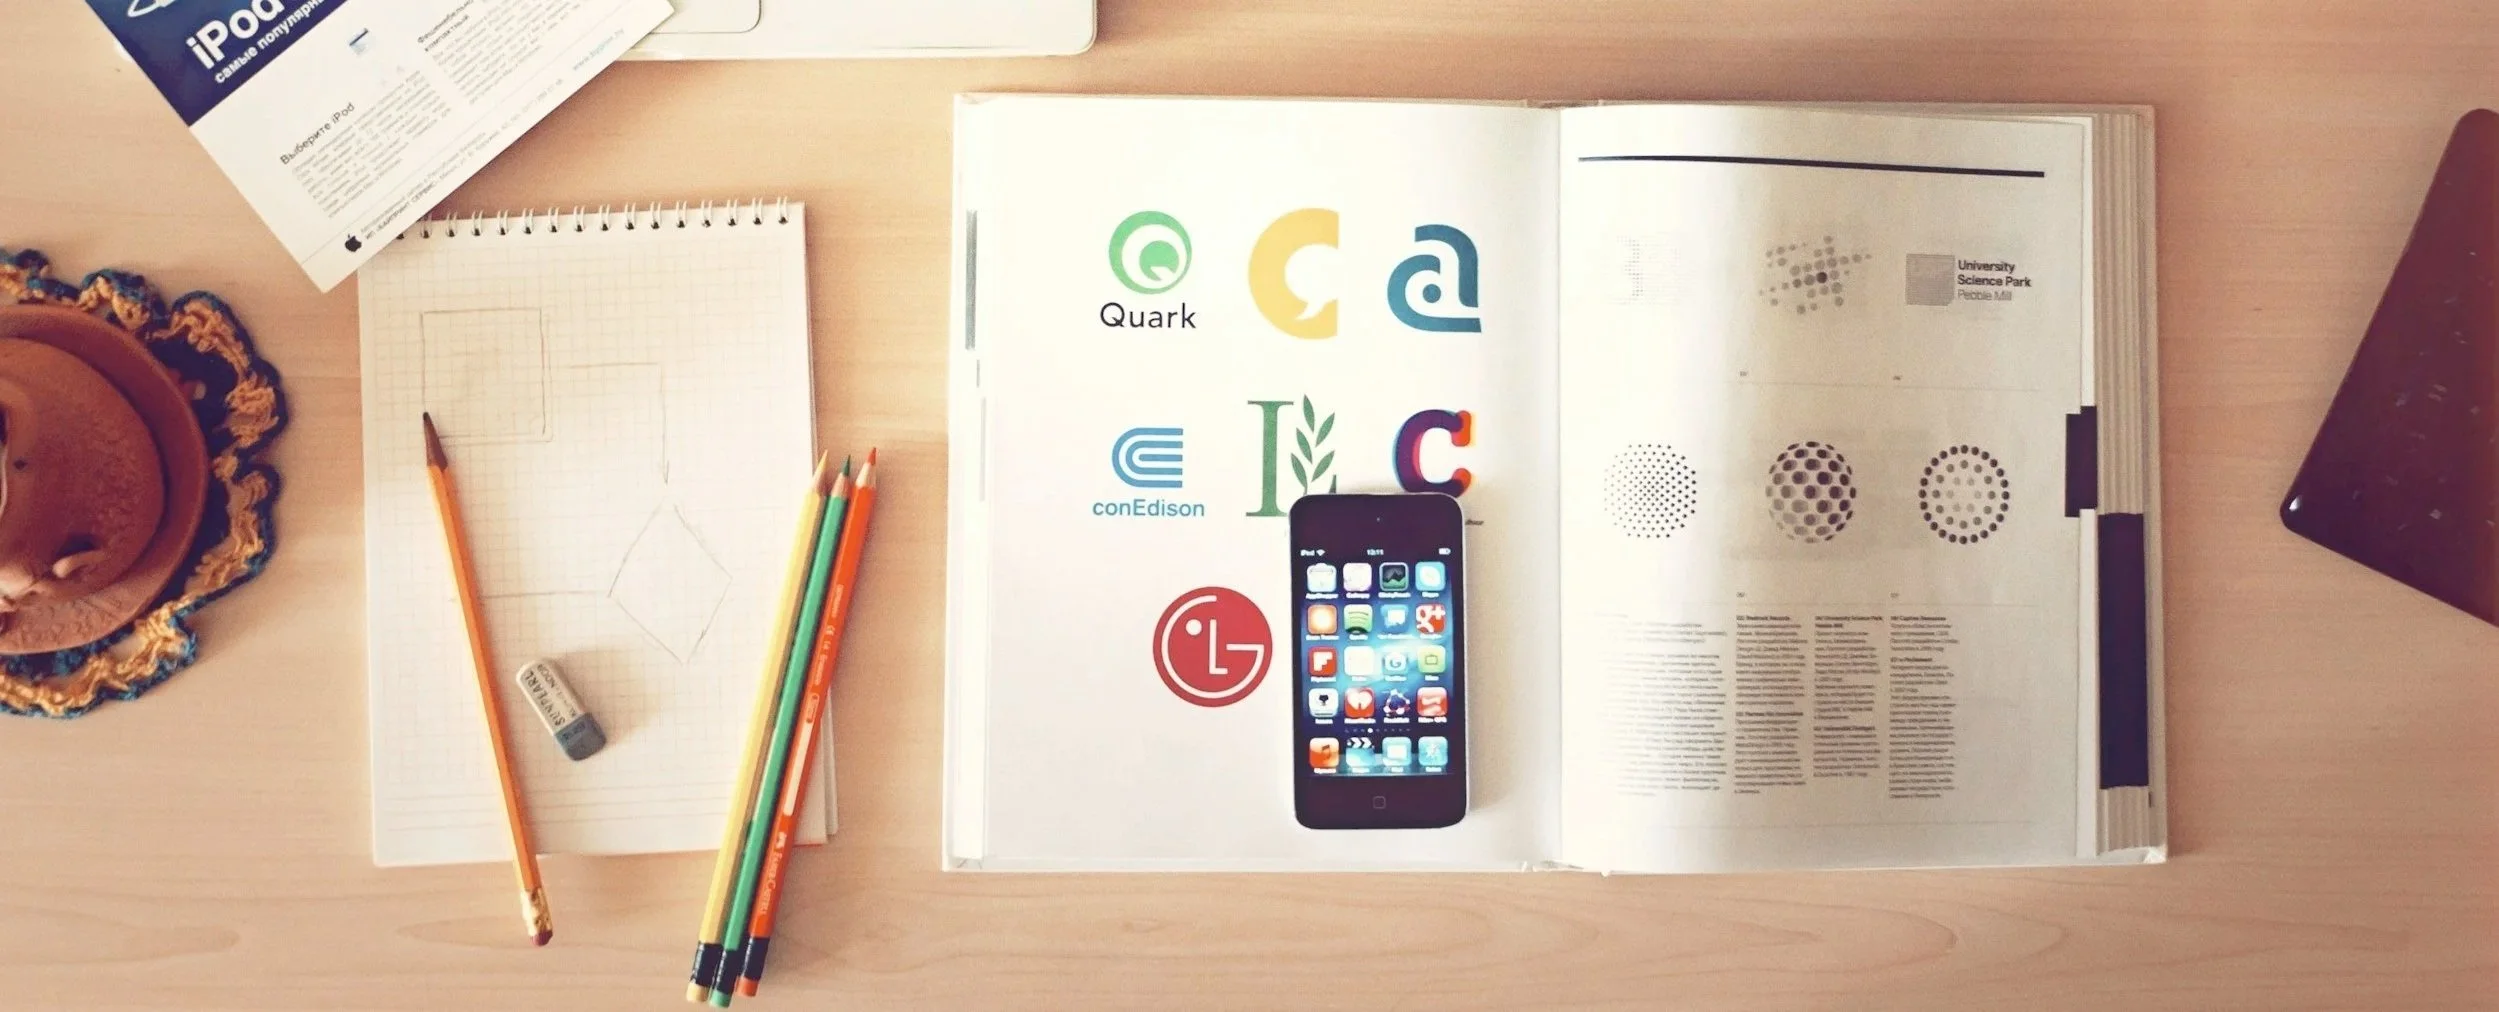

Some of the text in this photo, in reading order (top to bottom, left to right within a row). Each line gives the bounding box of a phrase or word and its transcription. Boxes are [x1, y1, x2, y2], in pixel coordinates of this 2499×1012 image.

[185, 0, 285, 70] iPod
[215, 46, 258, 83] самые
[280, 102, 355, 165] Выберите iPod
[1387, 224, 1482, 333] a
[1957, 259, 2016, 275] University
[1957, 274, 2032, 288] Science Park
[1099, 302, 1197, 330] Quark
[1091, 497, 1206, 518] conEdison
[1161, 594, 1265, 699] LG
